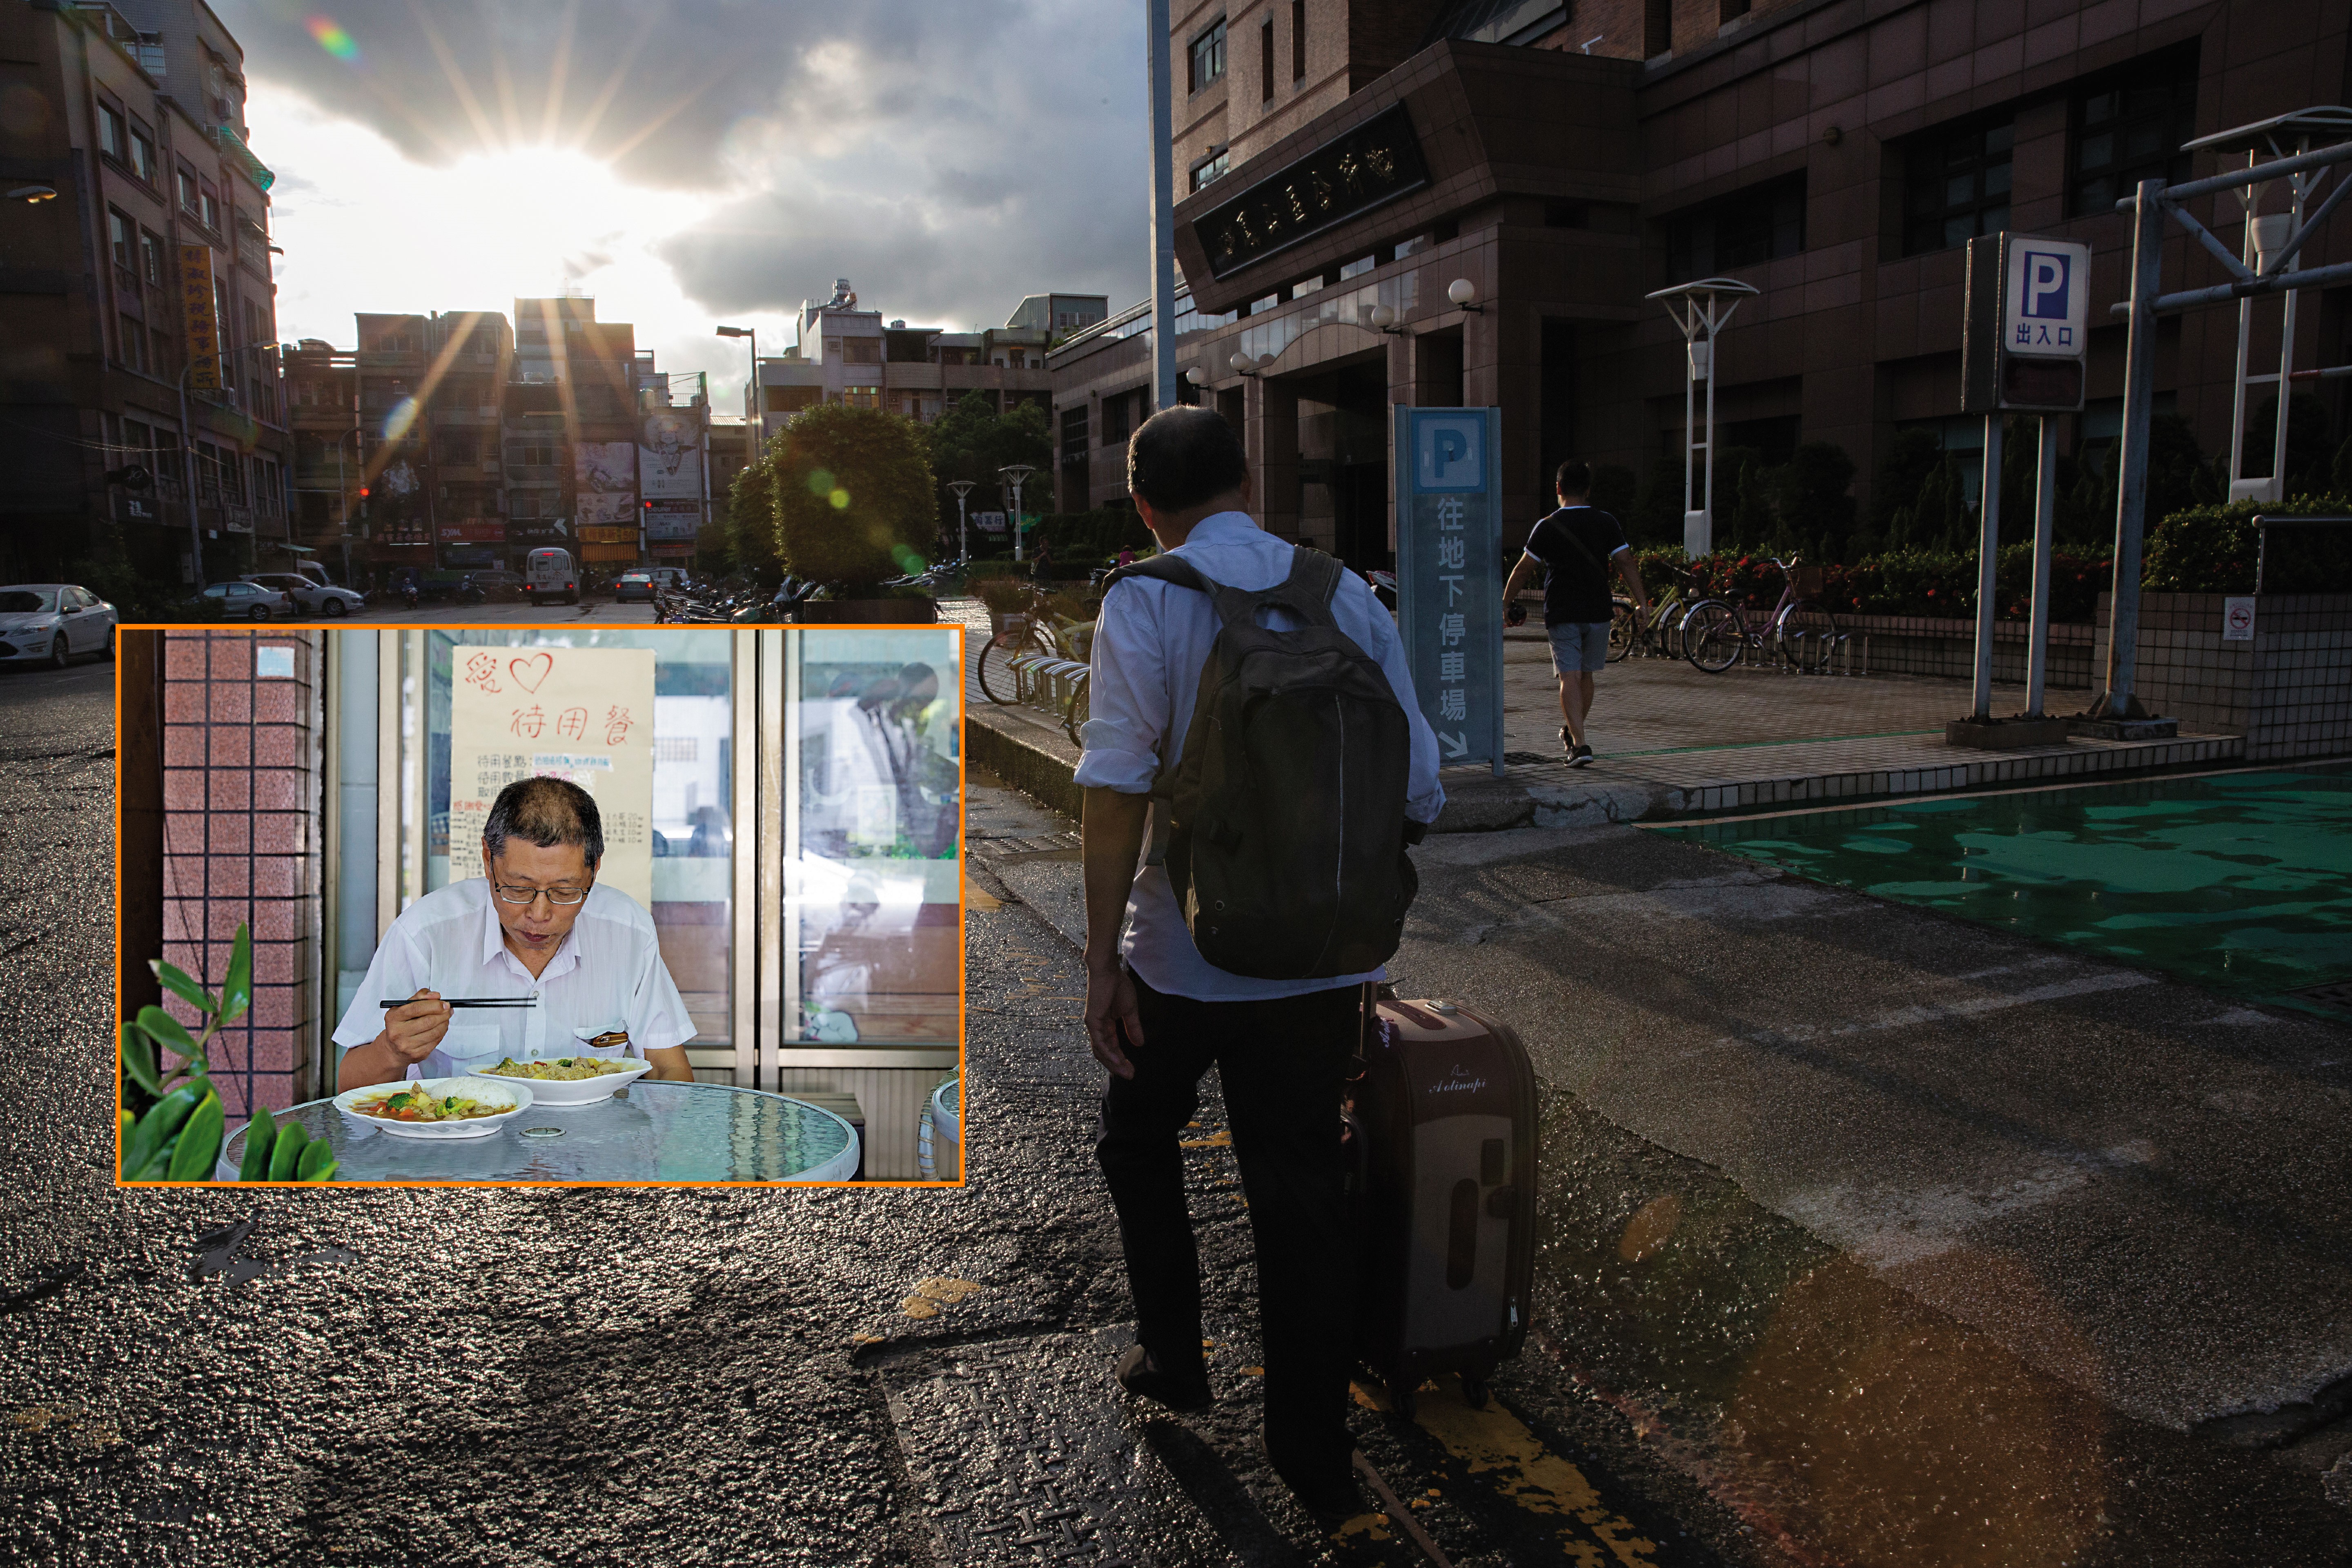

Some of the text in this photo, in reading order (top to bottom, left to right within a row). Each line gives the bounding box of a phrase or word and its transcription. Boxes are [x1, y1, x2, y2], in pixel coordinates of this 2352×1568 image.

[2027, 254, 2063, 316] P
[2016, 323, 2072, 347] 出入口
[1434, 429, 1467, 478] P
[1437, 497, 1466, 721] 往地下停車場
[466, 652, 502, 694] 愛
[510, 704, 634, 746] 待用餐
